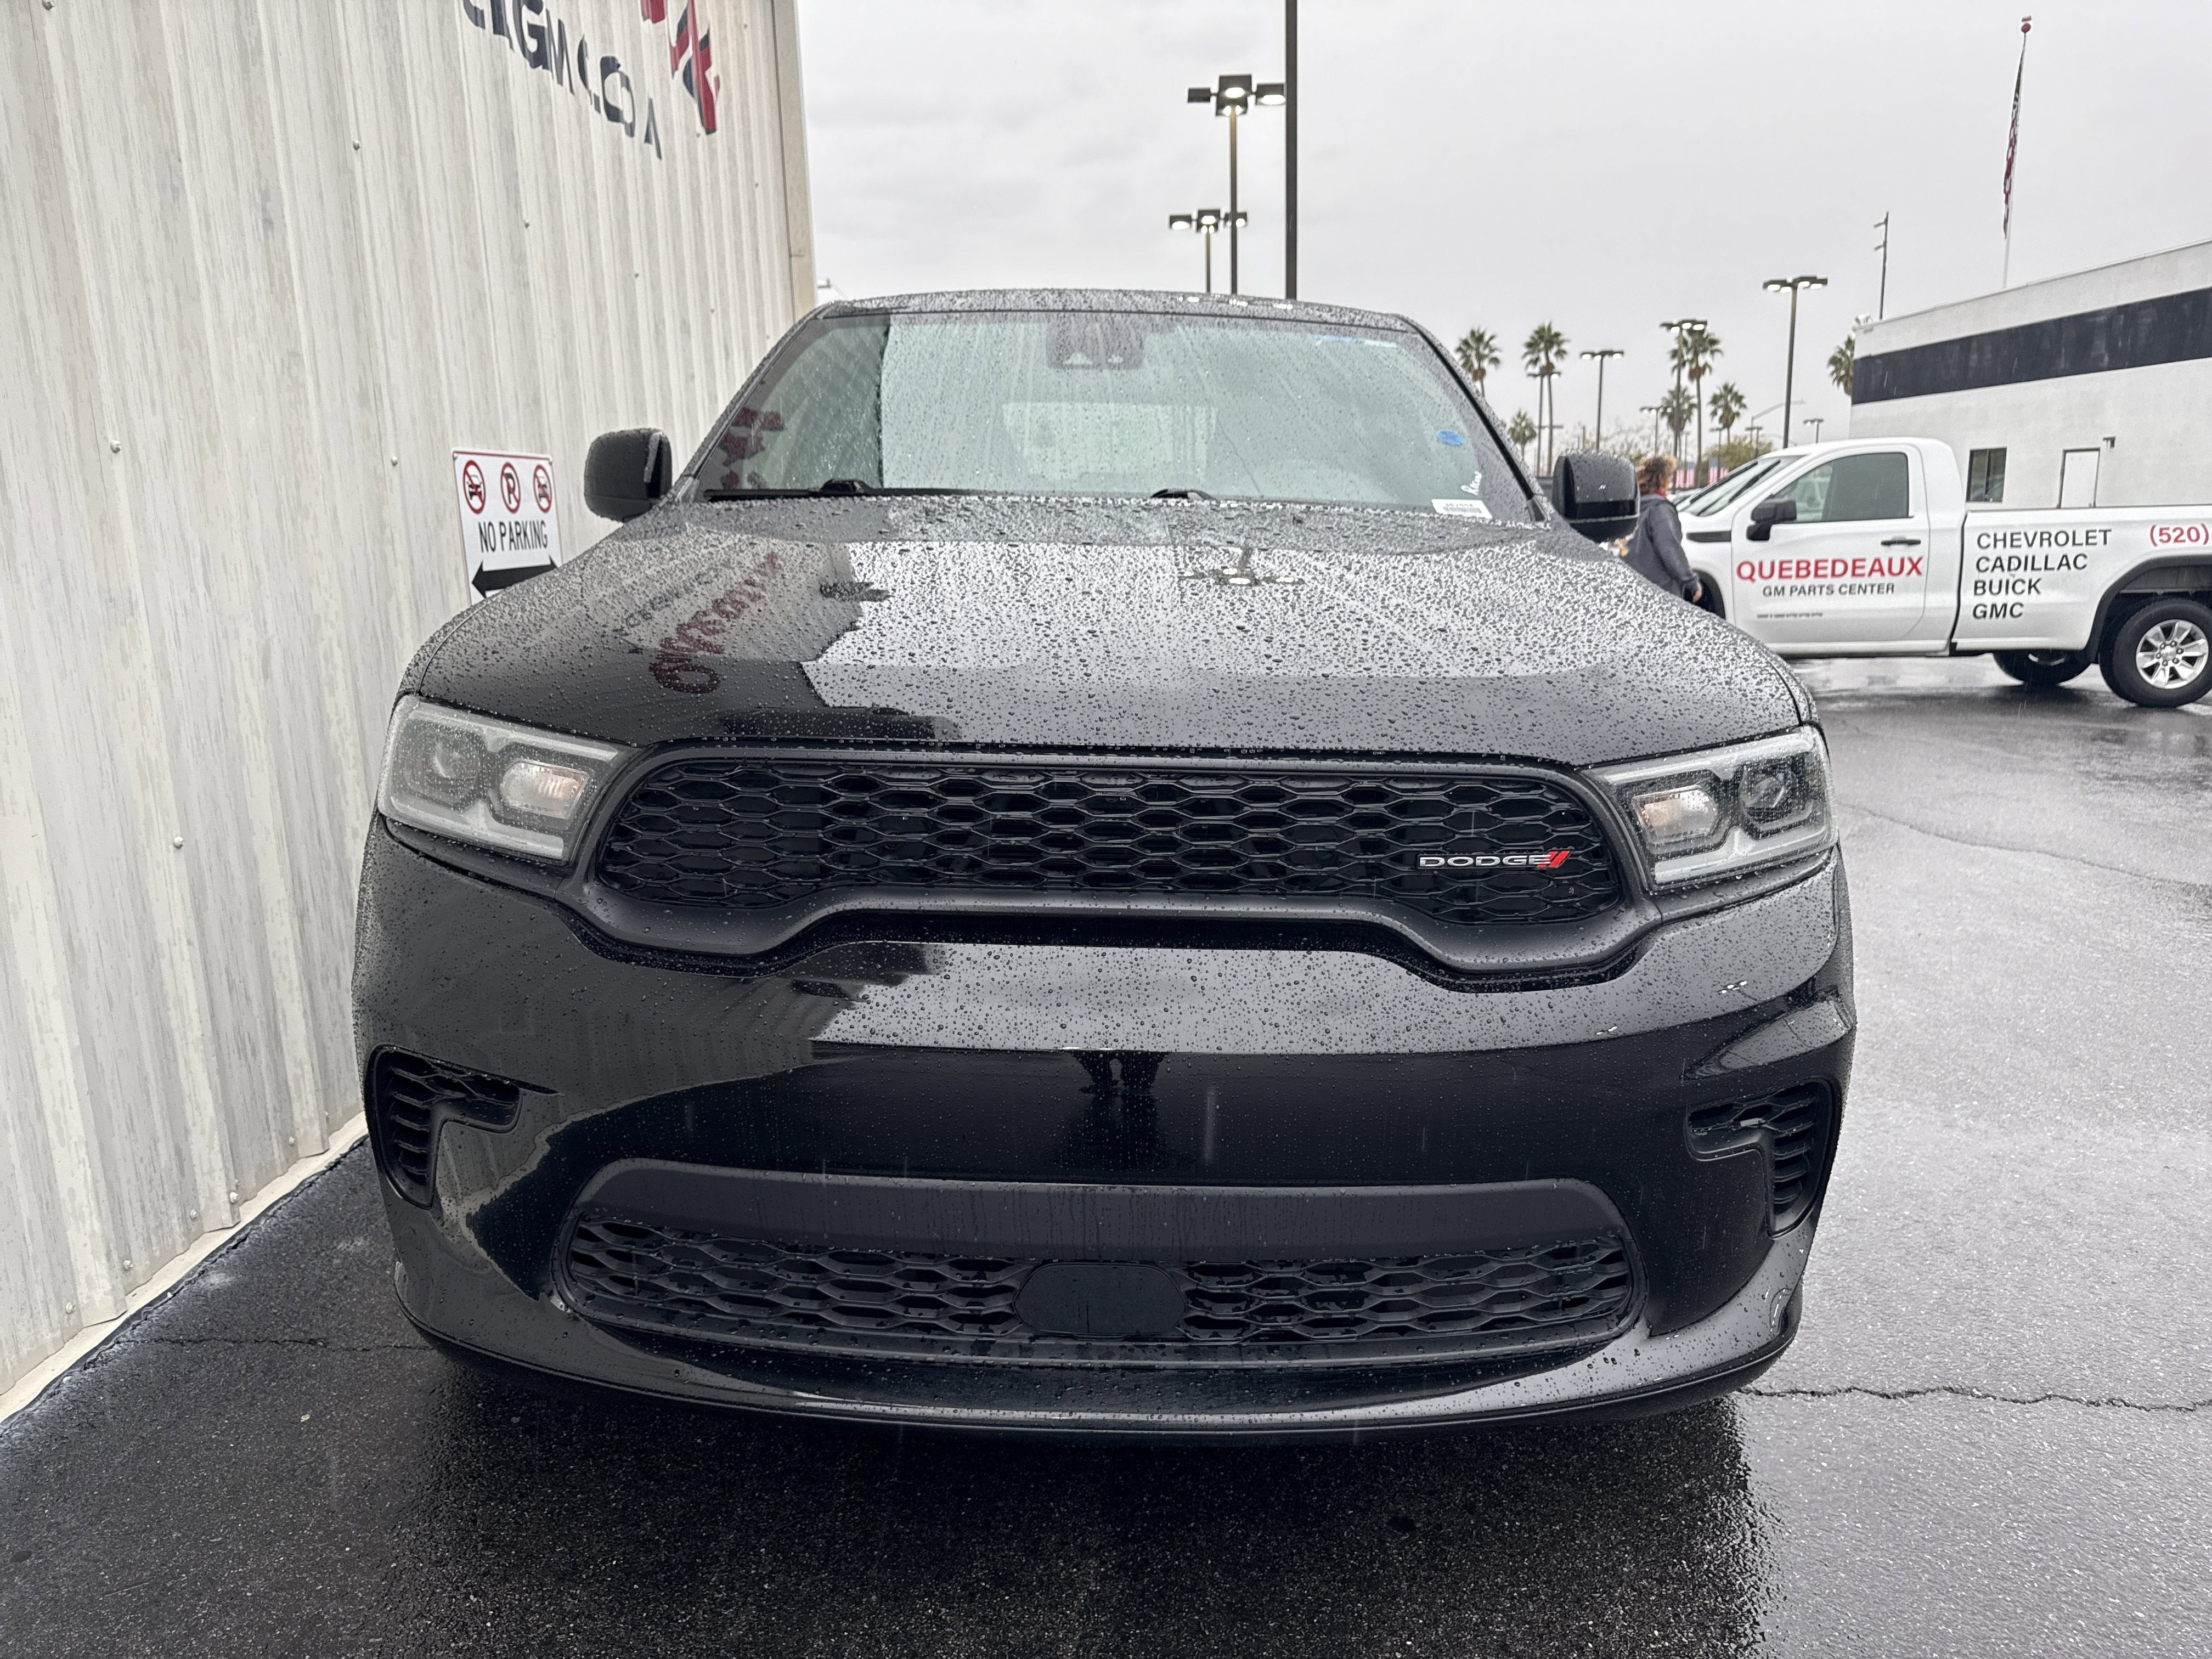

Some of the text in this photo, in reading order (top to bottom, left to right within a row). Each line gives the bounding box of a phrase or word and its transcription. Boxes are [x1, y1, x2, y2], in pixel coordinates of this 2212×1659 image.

[478, 520, 548, 553] NO PARKING
[1977, 528, 2112, 549] CHEVROLET
[2149, 523, 2210, 547] (520)
[1736, 556, 1925, 582] QUEBEDEAUX
[1976, 553, 2088, 573] CADILLAC
[1762, 583, 1895, 597] GM PARTS CENTER
[1973, 577, 2042, 596] BUICK
[1973, 602, 2024, 620] GMC
[1419, 854, 1552, 867] DODGE
